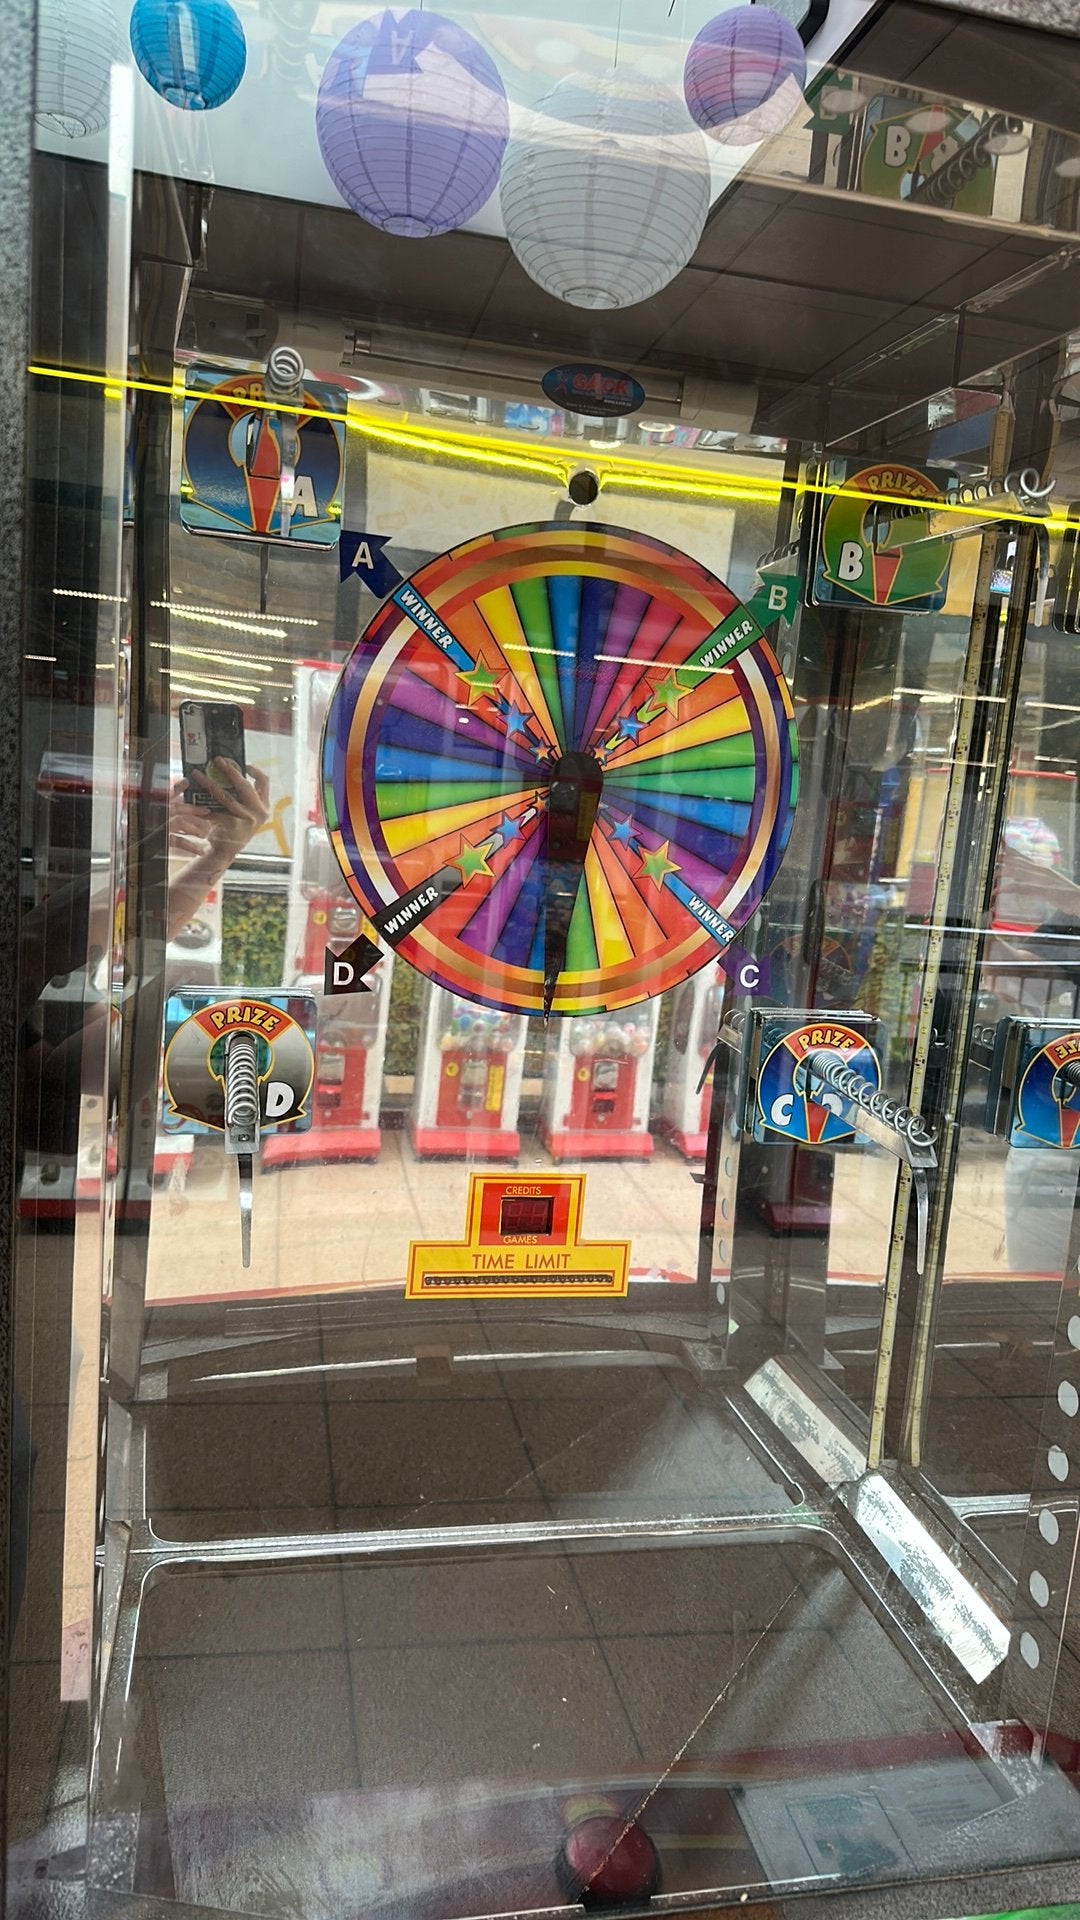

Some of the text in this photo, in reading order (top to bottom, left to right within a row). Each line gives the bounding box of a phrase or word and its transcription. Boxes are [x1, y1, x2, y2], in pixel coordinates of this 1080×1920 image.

[290, 474, 319, 518] A
[867, 470, 927, 498] PRIZE
[351, 541, 375, 570] A
[837, 540, 864, 582] B
[767, 584, 788, 611] B
[400, 589, 453, 650] WINNER
[699, 620, 754, 668] WINNER
[383, 886, 439, 935] WINNER
[687, 895, 735, 942] WINNER
[333, 961, 355, 986] D
[739, 964, 760, 988] C
[210, 1006, 281, 1033] PRIZE
[798, 1029, 855, 1051] PRIZE
[265, 1081, 295, 1117] D
[770, 1093, 794, 1127] C
[505, 1186, 542, 1196] CREDITS
[503, 1235, 538, 1245] GAMES
[472, 1253, 571, 1269] TIME LIMIT
